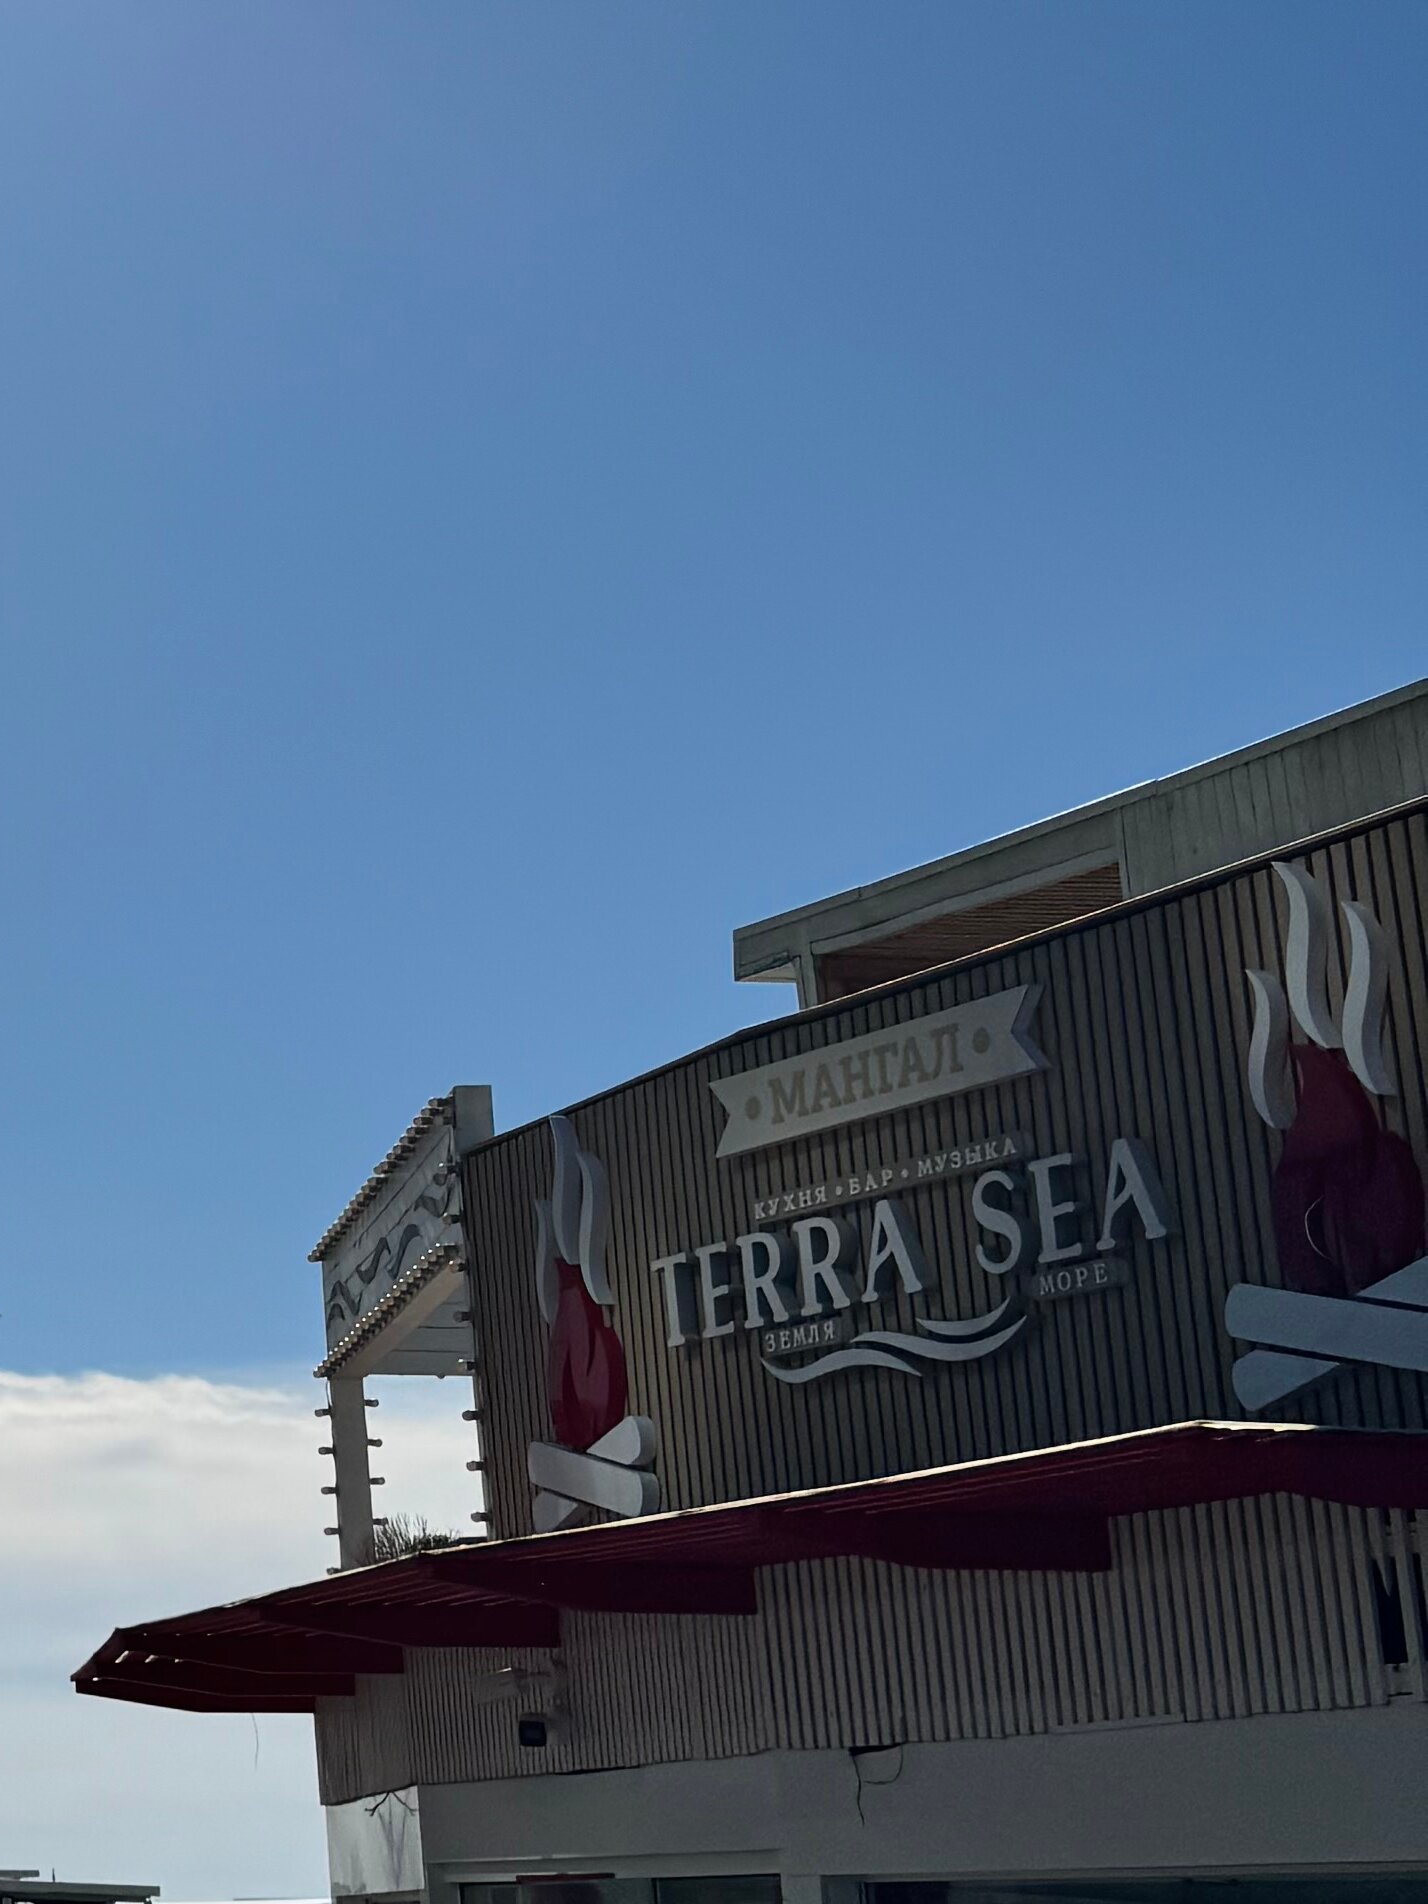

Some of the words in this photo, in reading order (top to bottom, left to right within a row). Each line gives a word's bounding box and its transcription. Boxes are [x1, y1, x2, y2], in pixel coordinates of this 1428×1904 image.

[767, 1023, 964, 1125] МАНГАЛ
[754, 1186, 828, 1220] КУХНЯ
[848, 1169, 894, 1196] БАР
[918, 1137, 1017, 1178] МУЗЫКА
[651, 1199, 924, 1348] TERRA
[972, 1138, 1167, 1275] SEA
[1039, 1263, 1109, 1296] МОРЕ
[765, 1320, 837, 1353] ЗЕМЛЯ
